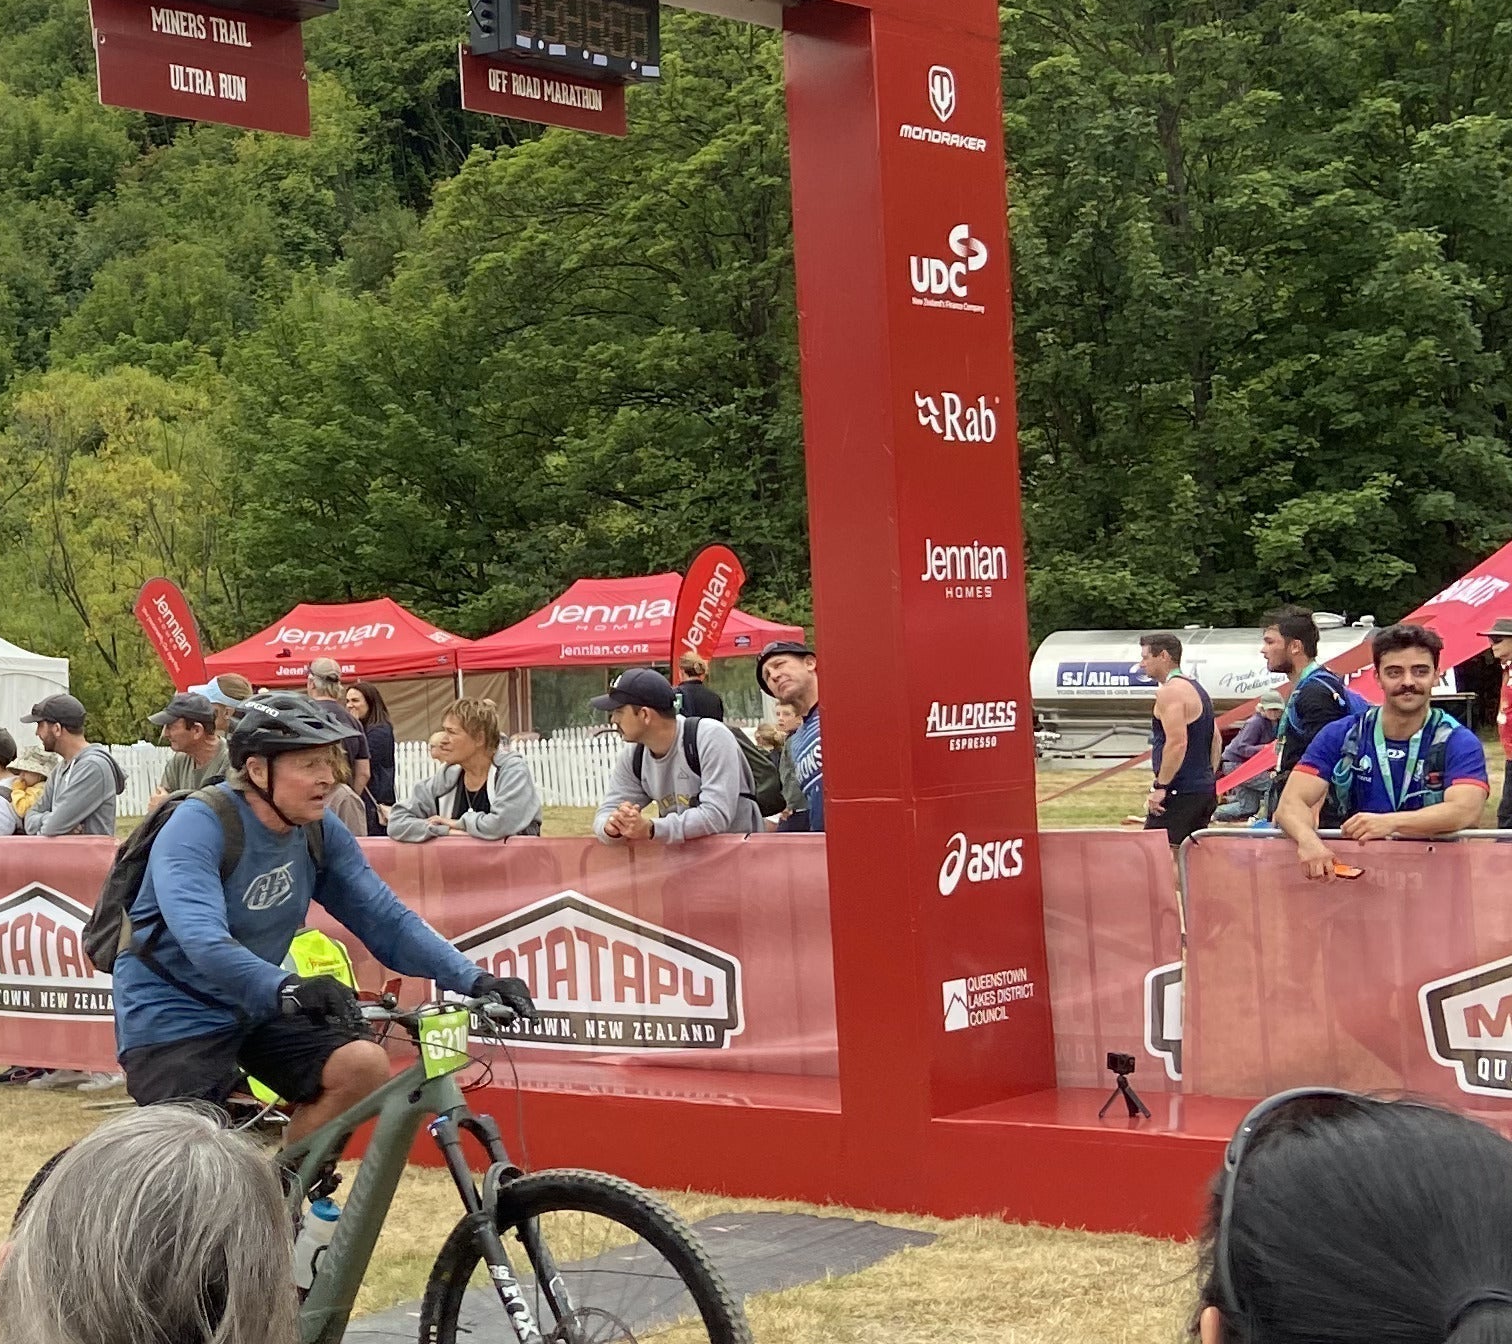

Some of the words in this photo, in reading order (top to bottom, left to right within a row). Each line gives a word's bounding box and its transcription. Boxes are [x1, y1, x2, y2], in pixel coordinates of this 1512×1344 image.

[150, 6, 207, 40] MINERS
[210, 16, 251, 48] TRAIL
[169, 63, 215, 98] ULTRA
[219, 72, 247, 102] RUN
[488, 68, 508, 93] OFF
[512, 72, 541, 100] ROAD
[543, 79, 603, 111] MARATHON
[899, 124, 986, 152] MONDRAKER
[910, 256, 967, 298] UDC
[942, 391, 996, 443] Rab
[921, 538, 1008, 582] Jennian
[946, 586, 993, 599] HOMES
[152, 594, 192, 657] Jennian
[537, 597, 676, 630] Jennia
[265, 623, 395, 646] Jennian
[1062, 671, 1083, 686] SJ
[1087, 671, 1130, 686] Allen
[927, 700, 1017, 734] ALLPRESS
[949, 736, 998, 752] ESPRESSO
[476, 926, 715, 1008] OTATAPU
[968, 968, 1027, 992] QUEENSTOWN
[40, 991, 68, 1009] NEW
[74, 993, 114, 1010] ZEALA
[968, 990, 996, 1009] LAKES
[997, 983, 1034, 1004] DISTRICT
[585, 1019, 623, 1040] NEW
[633, 1021, 716, 1042] ZEALAND
[970, 1006, 1009, 1027] COUNCIL
